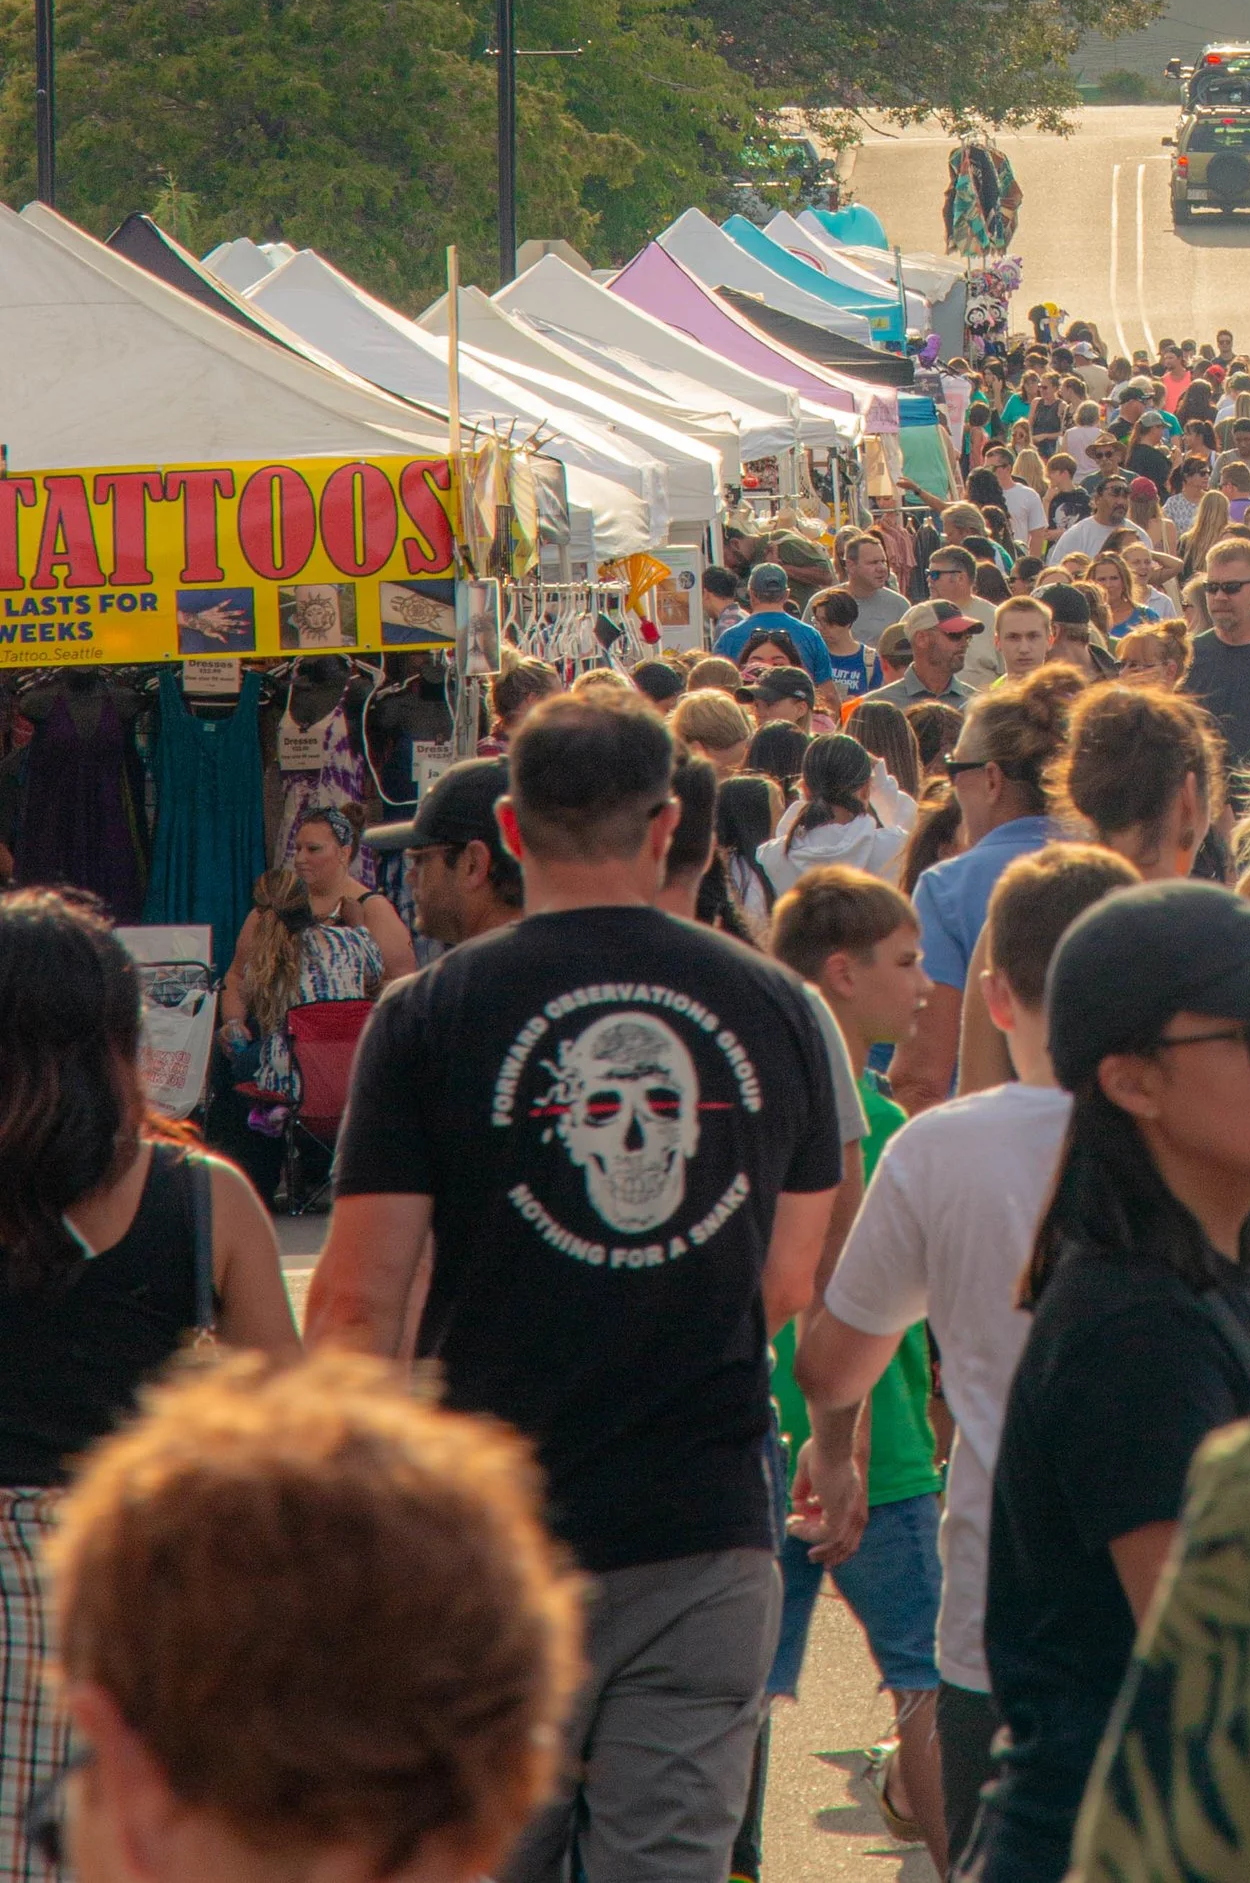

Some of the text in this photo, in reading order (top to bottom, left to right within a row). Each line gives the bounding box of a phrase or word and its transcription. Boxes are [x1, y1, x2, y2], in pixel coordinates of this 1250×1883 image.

[0, 459, 455, 591] TATTOOS
[4, 592, 158, 617] LASTS FOR
[0, 621, 94, 644] WEEKS
[284, 738, 318, 746] Dresses
[417, 745, 449, 753] Dress
[491, 983, 762, 1127] FORWARD OBSERVATIONS GROUP
[507, 1183, 606, 1265] NOTHING
[610, 1244, 665, 1268] FOR
[669, 1236, 688, 1260] A
